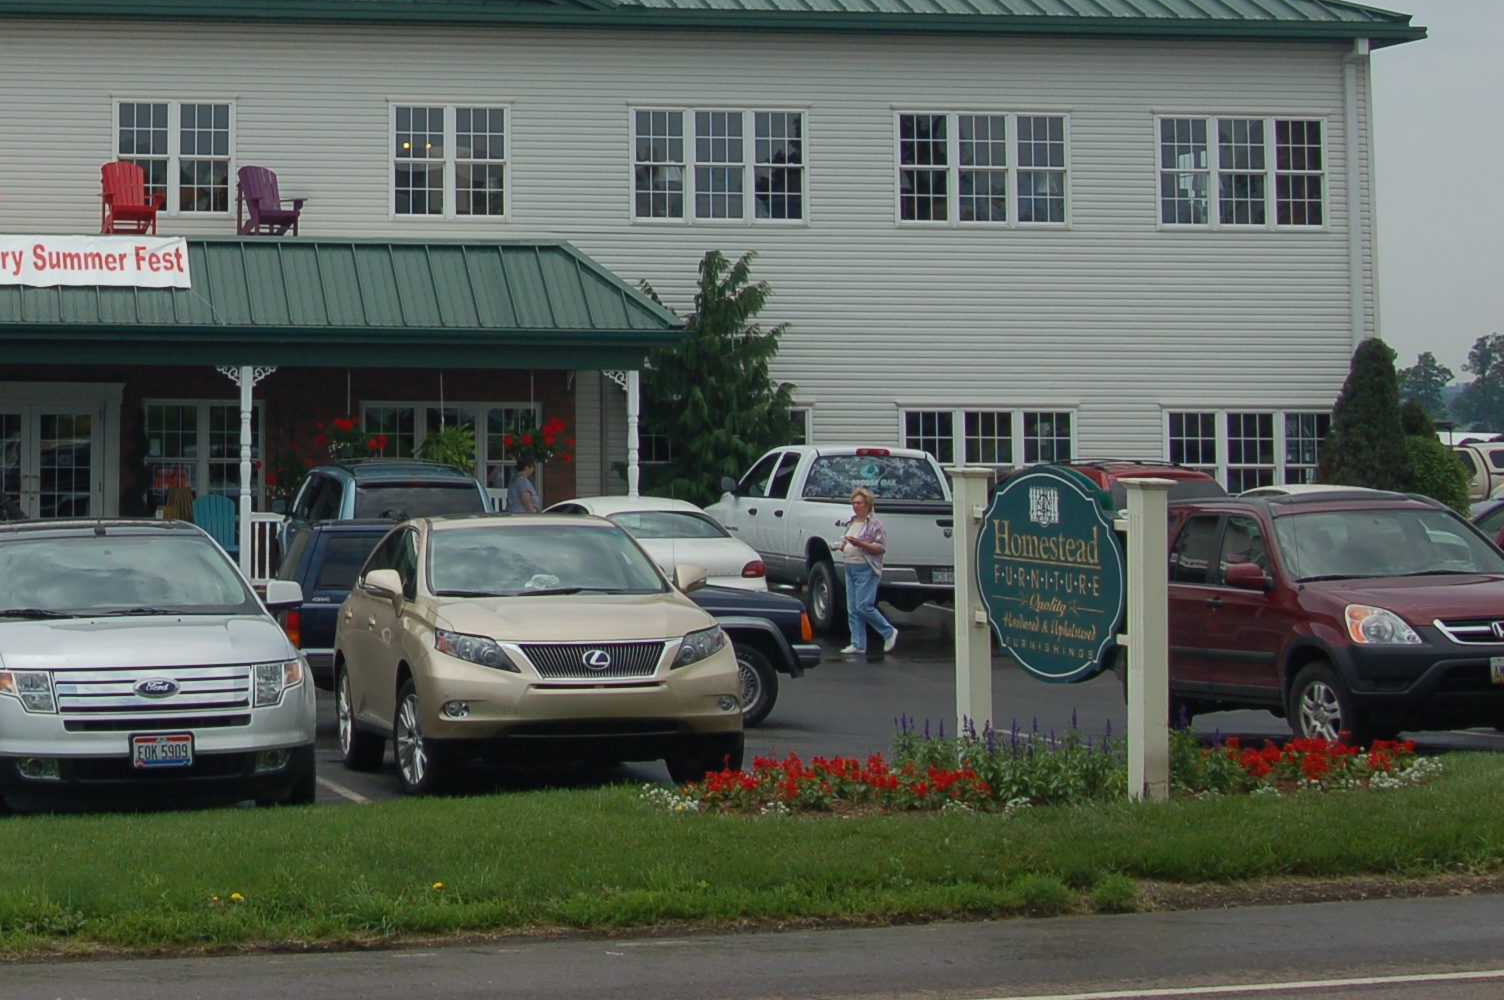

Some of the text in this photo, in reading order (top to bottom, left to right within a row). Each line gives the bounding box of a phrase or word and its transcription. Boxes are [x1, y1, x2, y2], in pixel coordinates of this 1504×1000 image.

[32, 243, 127, 271] Summer
[135, 246, 184, 273] Fest
[993, 519, 1099, 563] Homestead
[1029, 593, 1067, 617] Quality
[1006, 636, 1094, 659] FURNISHINGS
[161, 743, 188, 759] 5909
